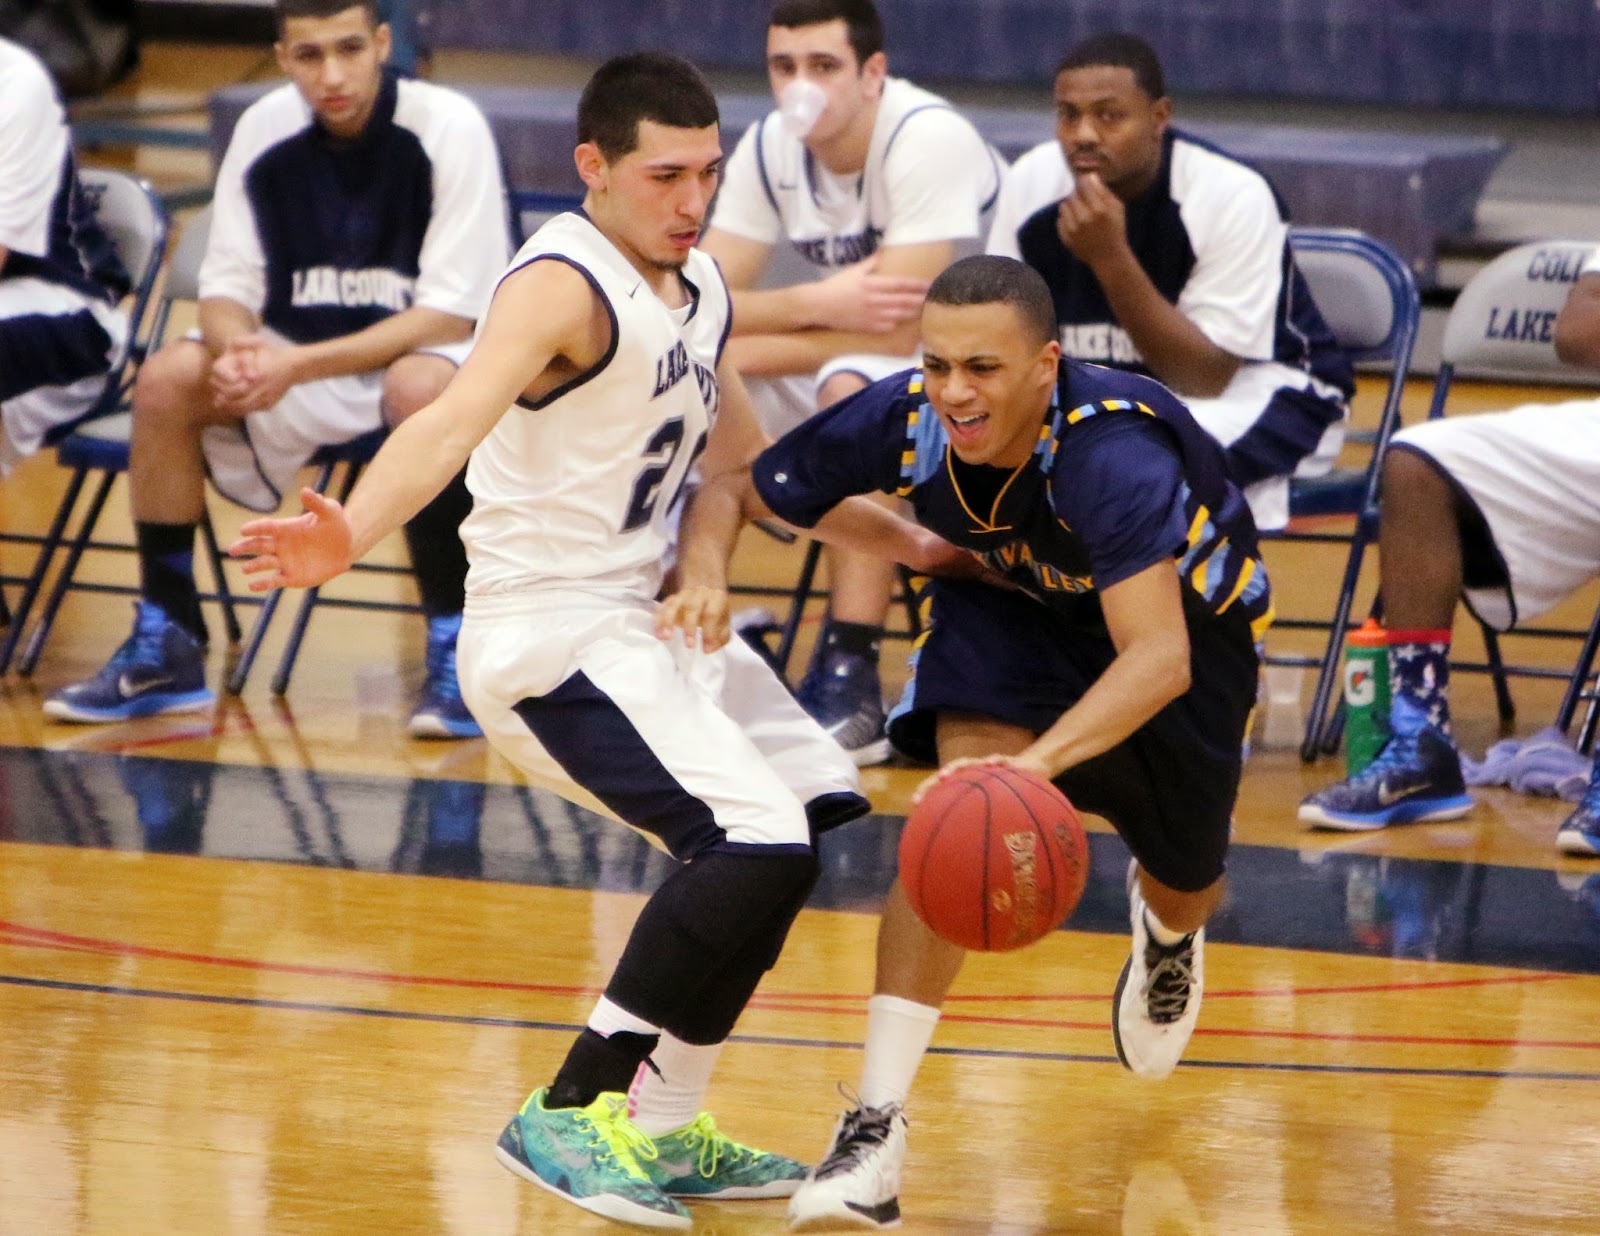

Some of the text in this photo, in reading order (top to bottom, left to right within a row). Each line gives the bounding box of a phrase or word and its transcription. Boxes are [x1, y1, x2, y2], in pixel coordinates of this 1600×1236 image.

[1527, 250, 1585, 282] COLL
[1485, 306, 1557, 342] LAKE
[1344, 658, 1375, 706] G
